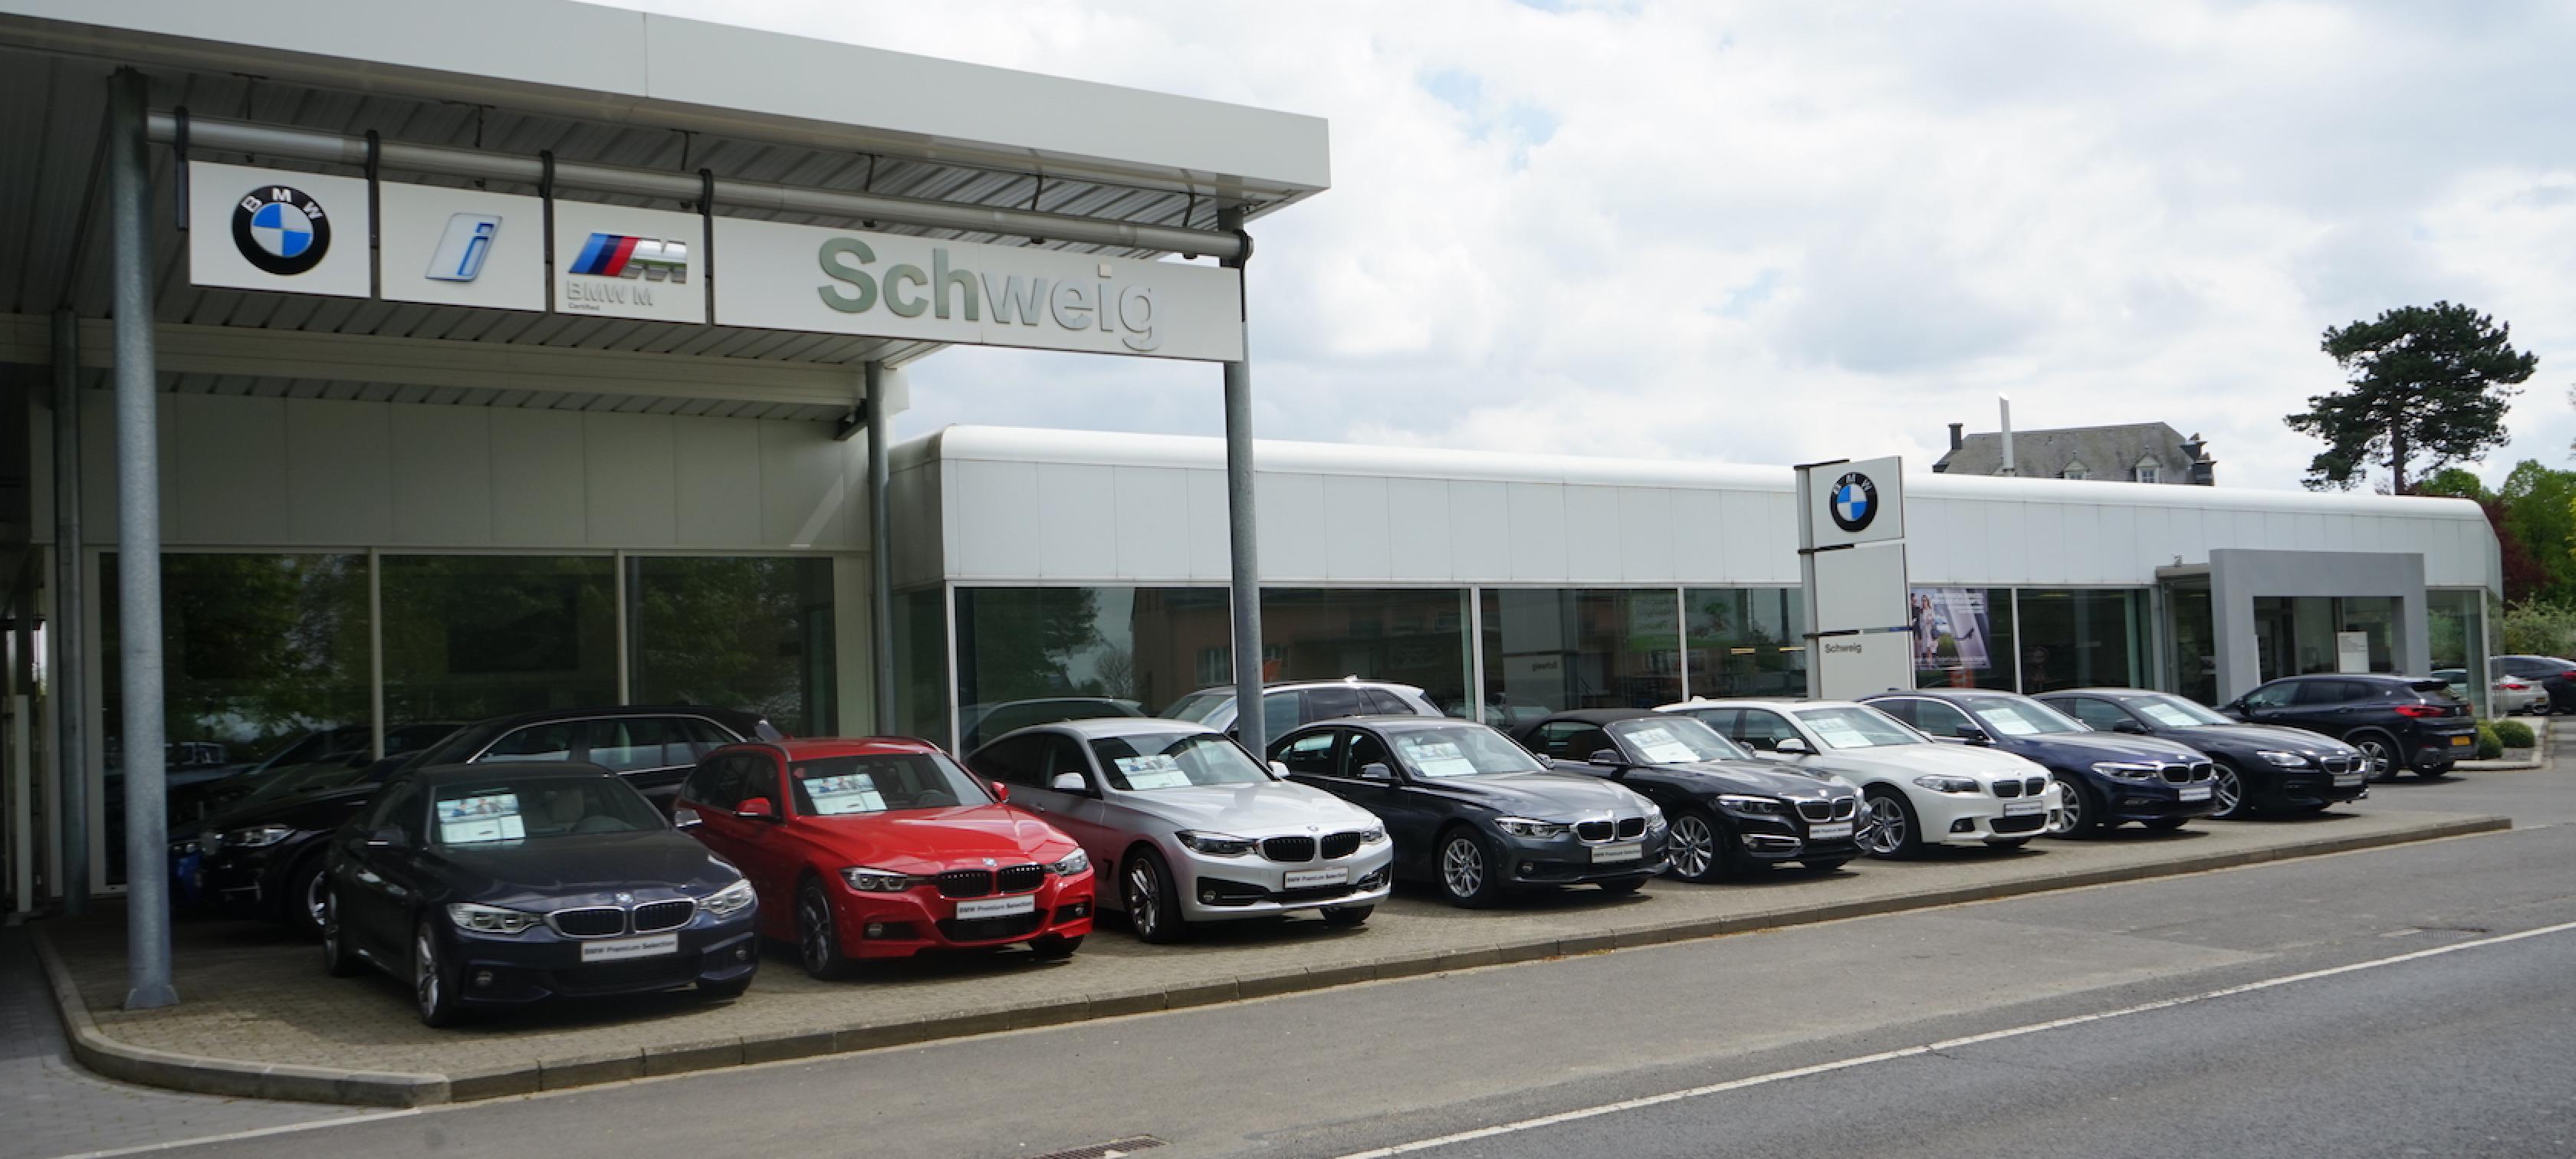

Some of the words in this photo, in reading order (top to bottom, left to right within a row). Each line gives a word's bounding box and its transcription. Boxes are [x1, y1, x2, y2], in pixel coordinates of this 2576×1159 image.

[242, 187, 322, 221] BMW
[566, 281, 626, 304] BMW
[632, 286, 653, 306] M
[816, 237, 1161, 351] Schweig
[1832, 473, 1873, 494] BMW
[1825, 642, 1862, 654] Schweig
